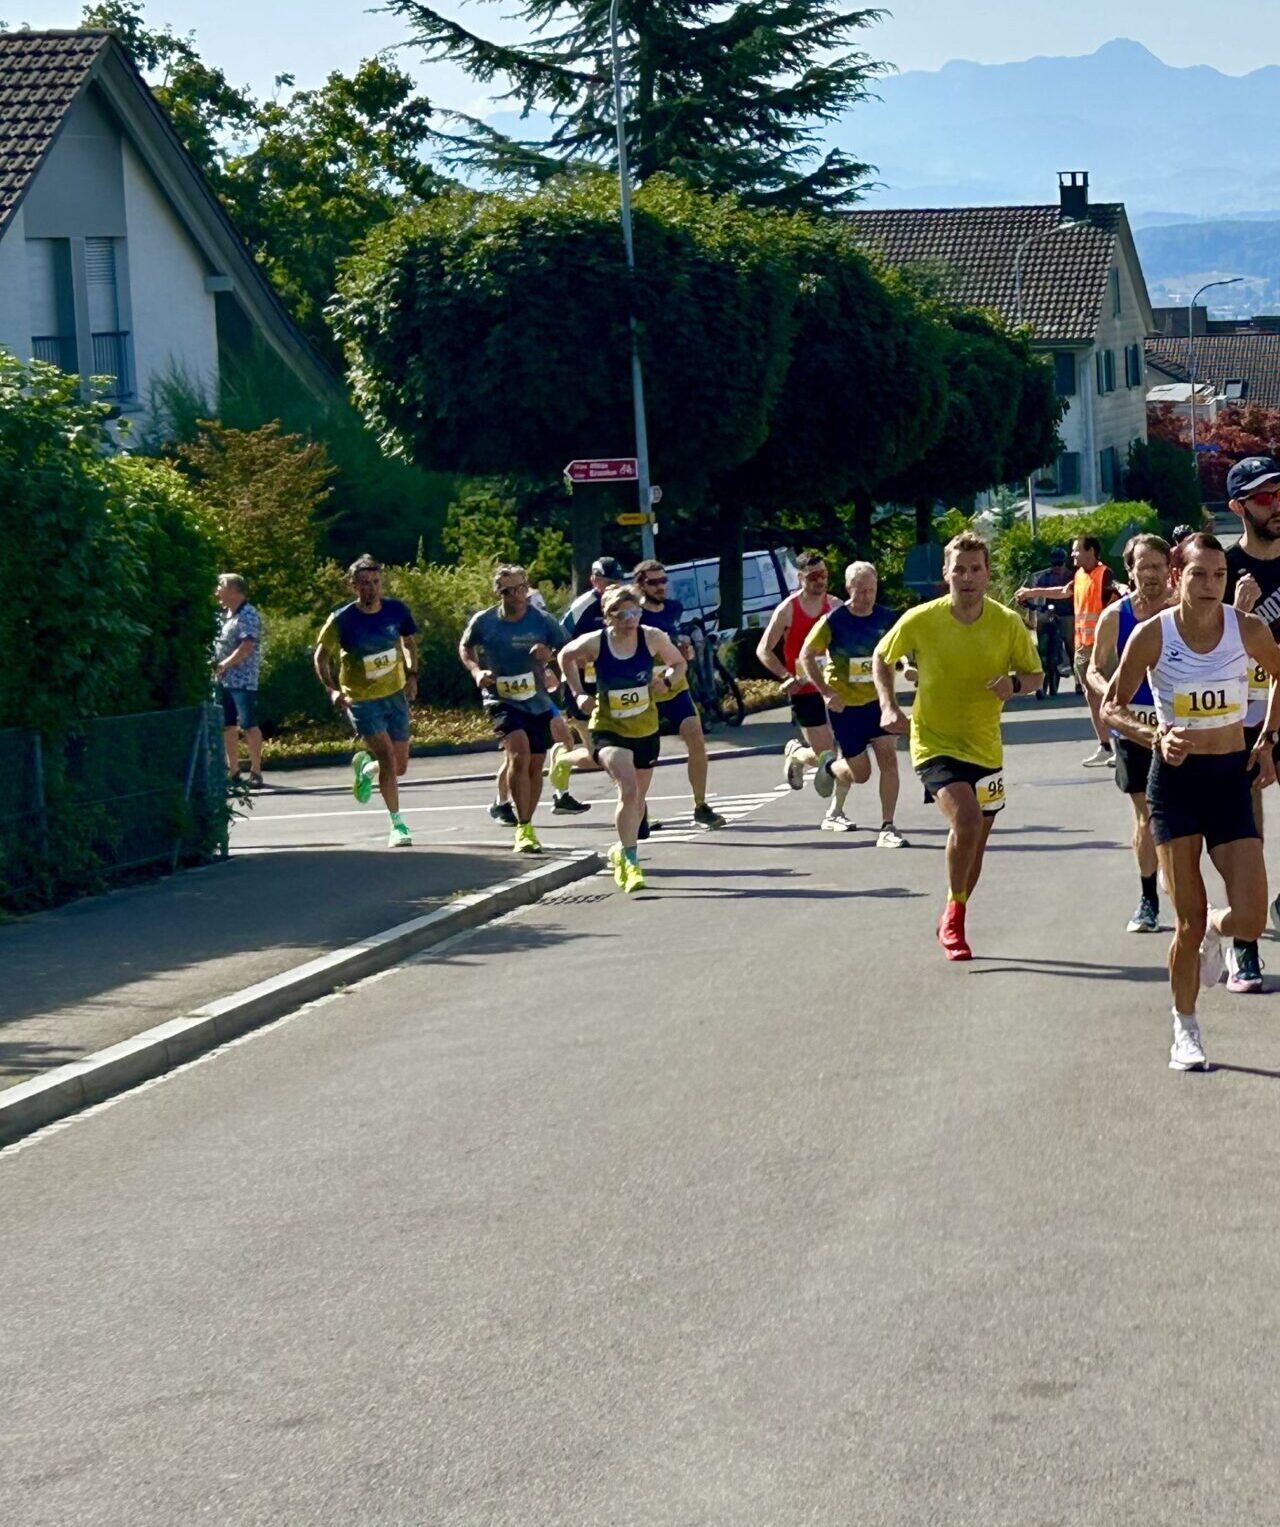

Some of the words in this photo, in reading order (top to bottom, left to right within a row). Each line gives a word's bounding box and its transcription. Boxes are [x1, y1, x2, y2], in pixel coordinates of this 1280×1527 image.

[1254, 664, 1267, 682] 8
[504, 679, 528, 692] 144
[621, 692, 639, 706] 50
[1189, 690, 1228, 711] 101
[988, 777, 1004, 798] 98
